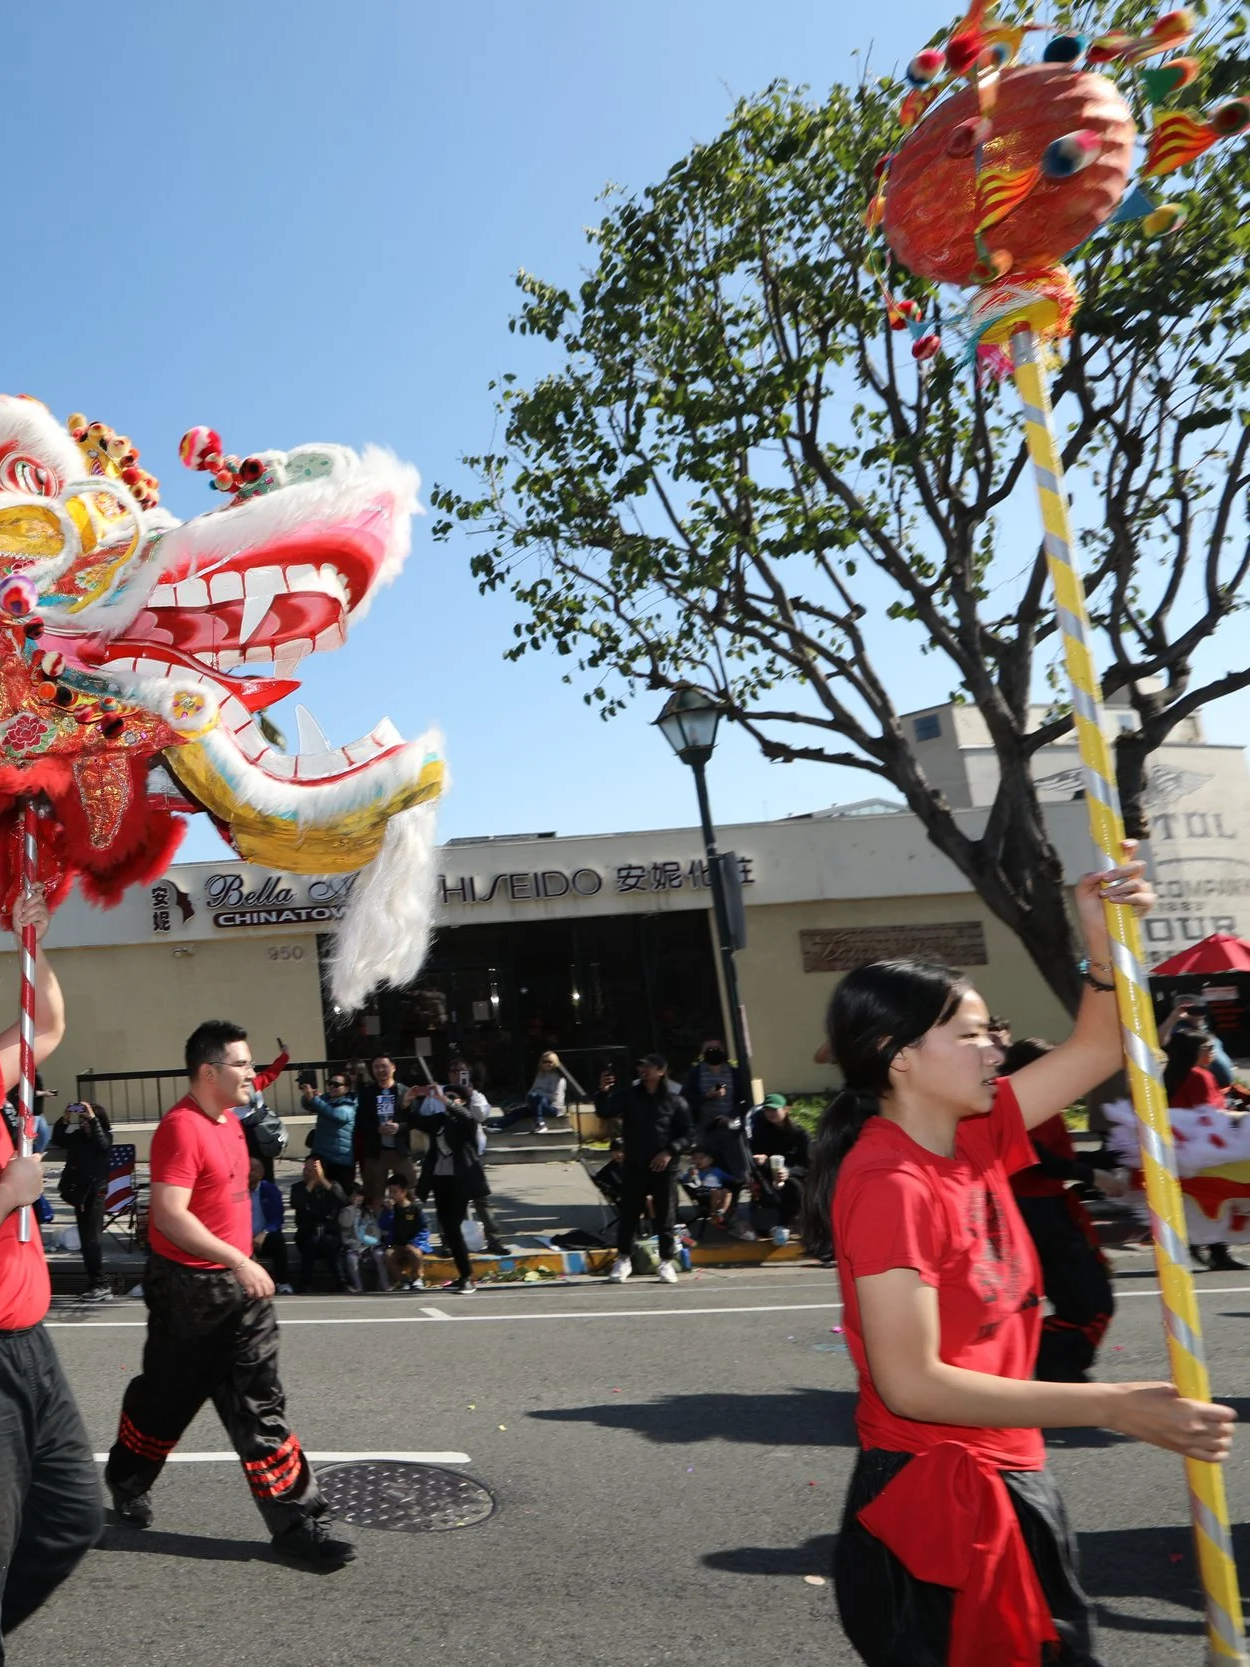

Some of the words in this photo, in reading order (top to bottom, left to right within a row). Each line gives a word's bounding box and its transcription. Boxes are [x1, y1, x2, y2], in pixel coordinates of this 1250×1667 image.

[204, 873, 297, 908] Bella
[438, 868, 602, 904] HISEIDO
[151, 886, 171, 932] 安妮
[217, 907, 347, 926] CHINATO
[267, 945, 305, 961] 950
